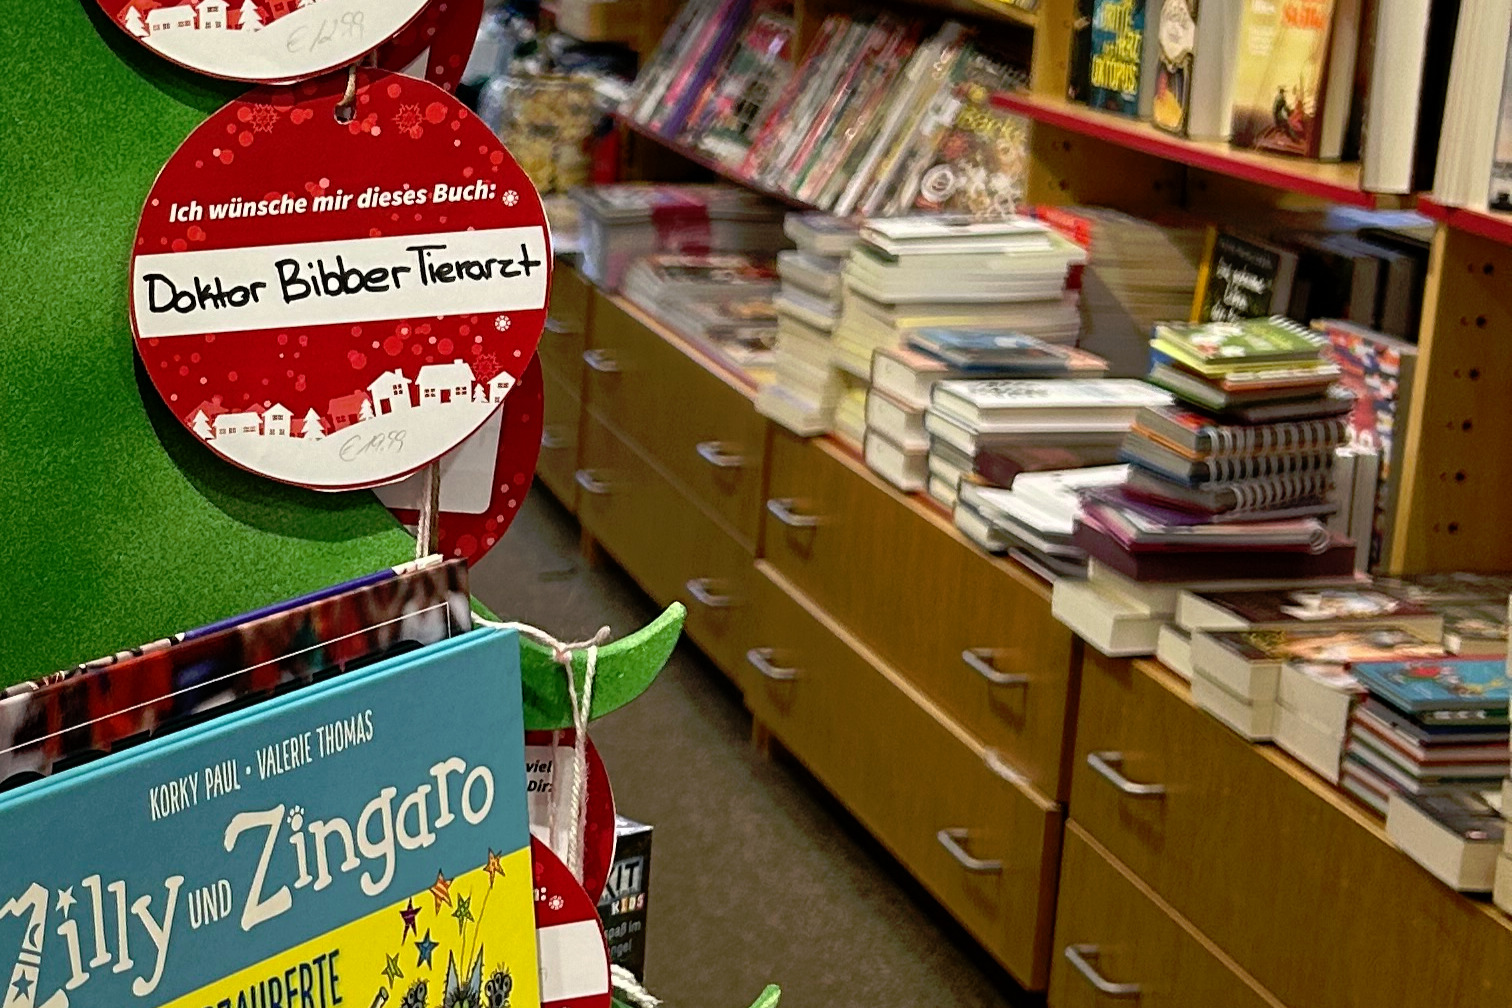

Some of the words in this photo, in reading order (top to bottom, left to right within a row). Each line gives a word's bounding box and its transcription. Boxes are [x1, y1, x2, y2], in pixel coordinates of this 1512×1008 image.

[169, 202, 202, 223] Ich
[209, 191, 308, 220] wünsche
[312, 190, 355, 212] mir
[357, 186, 428, 210] dieses
[433, 180, 496, 203] Buch:
[142, 270, 267, 315] Doktor
[275, 254, 412, 304] Bibber
[407, 243, 541, 287] Tierarzt
[149, 771, 198, 821] KORKY
[205, 759, 241, 800] PAUL
[257, 732, 313, 780] VALERIE
[316, 709, 375, 760] THOMAS
[223, 756, 495, 932] Zingaro
[188, 879, 233, 930] UND
